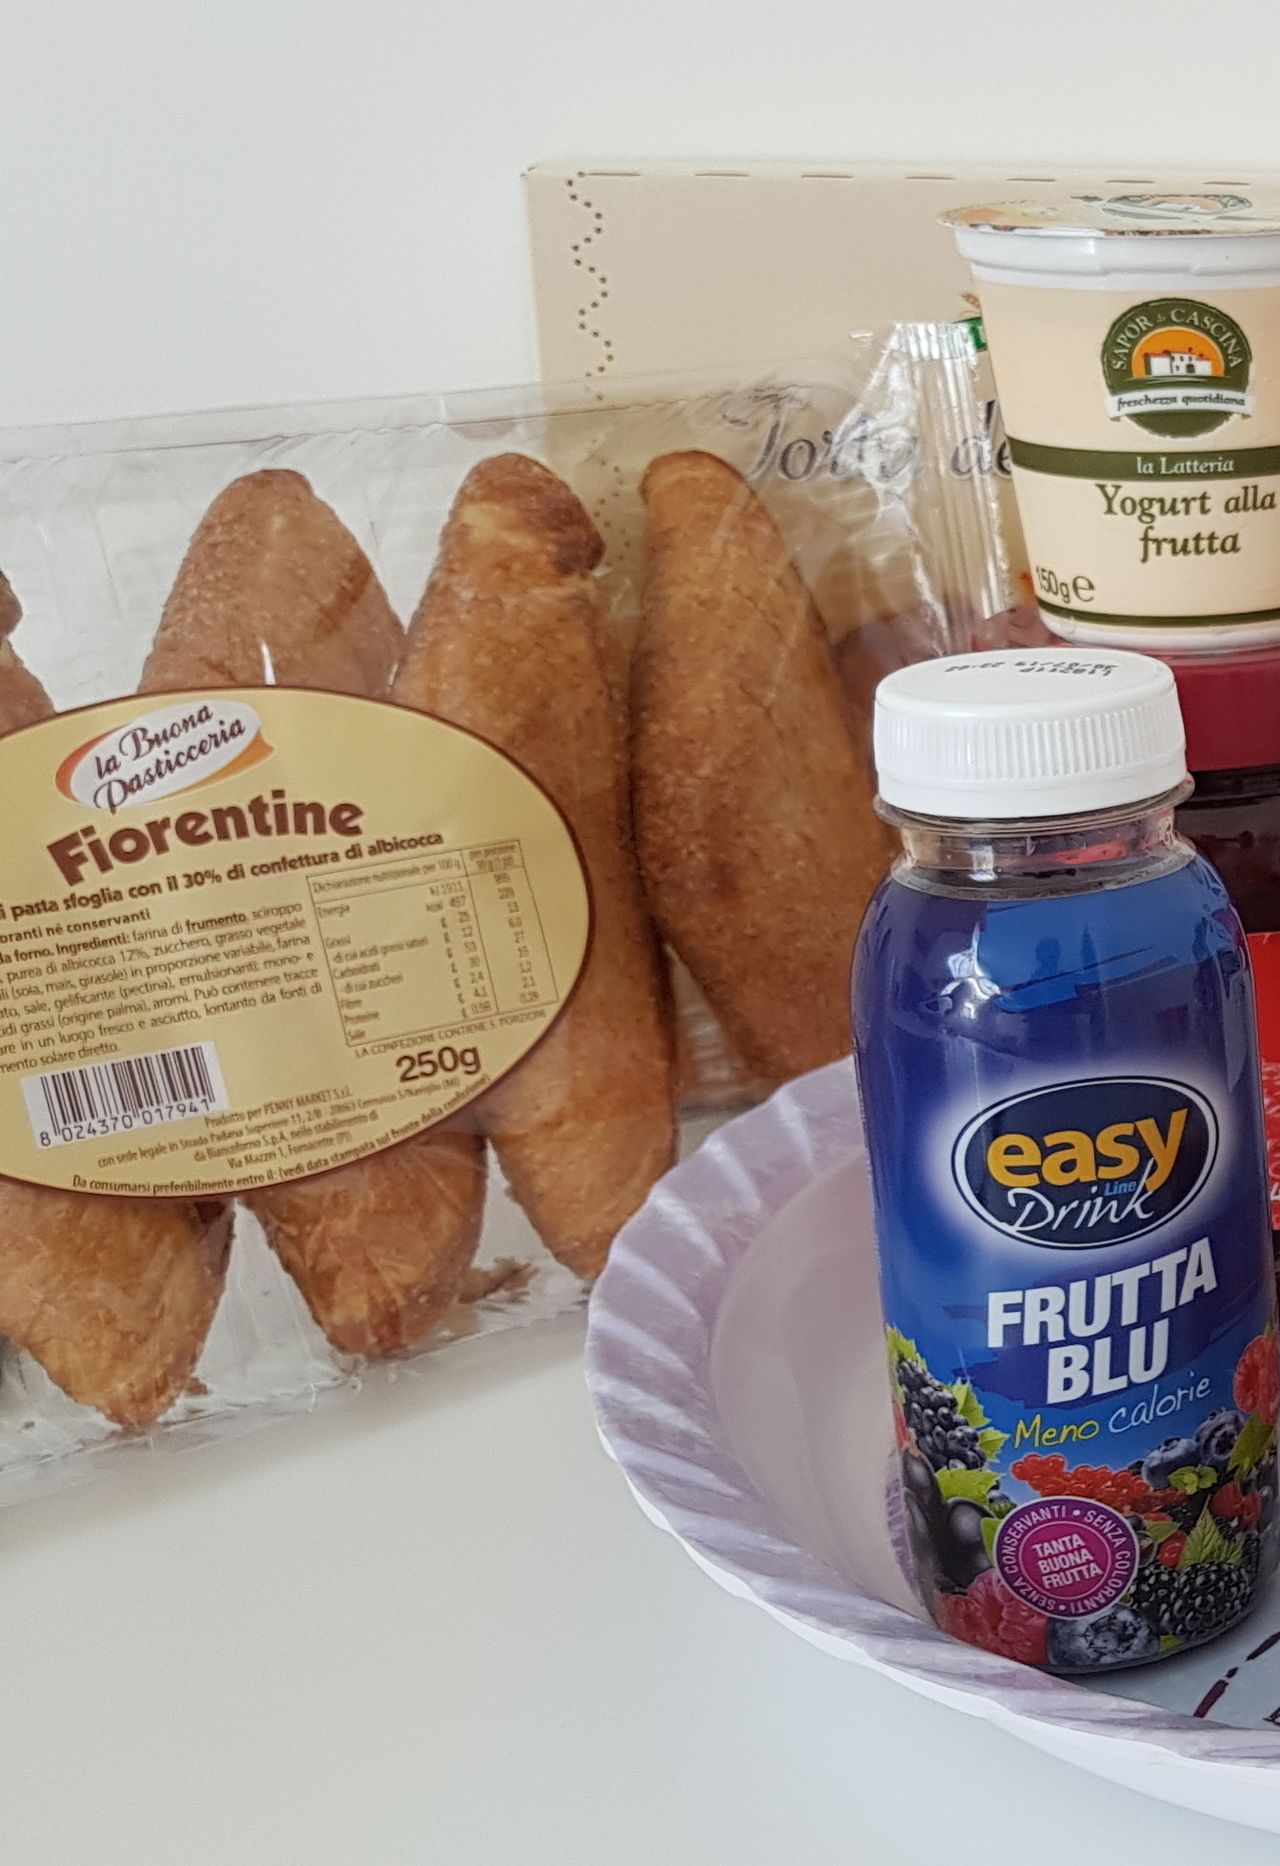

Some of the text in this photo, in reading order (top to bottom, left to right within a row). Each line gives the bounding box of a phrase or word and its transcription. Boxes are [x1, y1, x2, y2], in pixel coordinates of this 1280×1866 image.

[1111, 313, 1153, 371] SAPOR
[1171, 308, 1243, 370] CASCINA
[1117, 391, 1246, 411] freschezza quotidiana
[1136, 456, 1235, 474] la Latteria
[1095, 483, 1277, 525] Yogurt alla
[1138, 526, 1242, 564] frutta
[94, 717, 246, 816] Pasticceria
[96, 704, 214, 780] la Buona
[47, 789, 365, 887] Fiorentine
[10, 899, 60, 921] pasta
[63, 887, 124, 910] sfoglia
[128, 882, 163, 899] con
[166, 875, 180, 891] il
[184, 868, 223, 890] 30%
[227, 862, 246, 881] di
[250, 849, 340, 878] confettura
[346, 843, 364, 861] di
[367, 831, 445, 858] albicocca
[7, 917, 307, 983] purea di albicocca grasso vegetale
[45, 907, 152, 937] né conservanti
[55, 901, 303, 955] Ingredienti: farina di sciroppo
[130, 966, 143, 979] in
[145, 950, 221, 977] proporzione
[276, 934, 311, 950] farina
[20, 967, 318, 1036] grassi (origine Può contenere tracce
[21, 1039, 34, 1050] in
[38, 1035, 55, 1048] un
[58, 1027, 96, 1044] luogo
[98, 1021, 135, 1036] fresco
[261, 990, 277, 1005] da
[53, 988, 117, 1012] gelificante
[39, 1050, 77, 1066] solare
[395, 1045, 482, 1083] 250g
[39, 1131, 51, 1147] 8
[62, 1113, 134, 1143] 024370
[142, 1098, 208, 1126] 017941
[986, 1107, 1188, 1193] easy
[1007, 1158, 1155, 1232] Drink Line
[987, 1236, 1218, 1349] FRUTTA
[1046, 1317, 1170, 1405] BLU
[1013, 1369, 1213, 1451] Meno calorie
[1001, 1505, 1067, 1575] CONSERVANTI
[1031, 1533, 1086, 1557] TANTA
[1037, 1547, 1095, 1576] BUONA
[1069, 1509, 1132, 1615] SENZA COLORANTI
[1013, 1576, 1057, 1612] SENZA
[1042, 1562, 1105, 1590] FRUTTA
